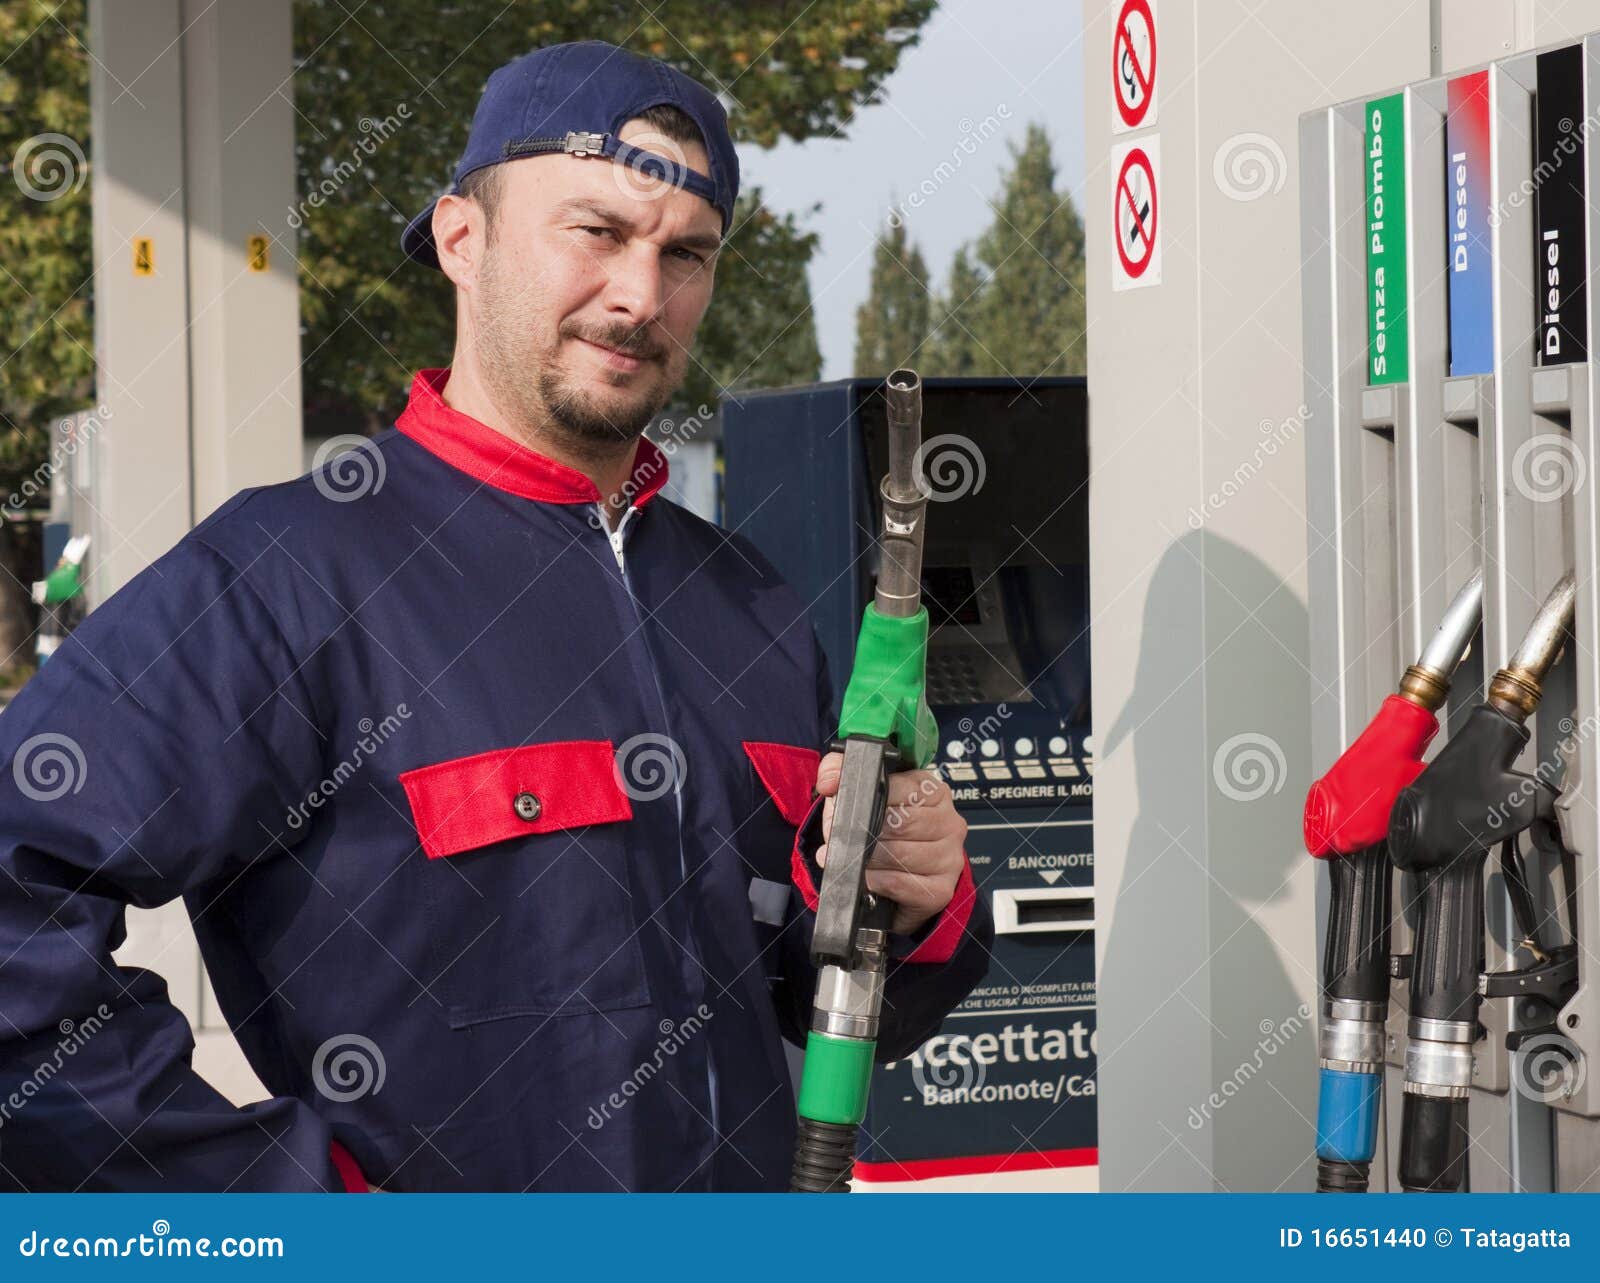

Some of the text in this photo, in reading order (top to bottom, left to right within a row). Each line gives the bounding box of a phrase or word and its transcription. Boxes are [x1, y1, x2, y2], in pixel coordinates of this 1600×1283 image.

[1452, 152, 1468, 272] Diesel
[136, 240, 152, 272] 4
[251, 237, 266, 270] 3
[1369, 109, 1387, 376] Senza Piombo
[1543, 229, 1560, 355] Diesel
[989, 785, 1056, 800] SPEGNERE
[1058, 785, 1069, 796] IL
[1008, 853, 1094, 870] BANCONOTE
[964, 999, 983, 1009] CHE
[1021, 982, 1079, 994] INCOMPLETA
[885, 1021, 1097, 1069] ccettat
